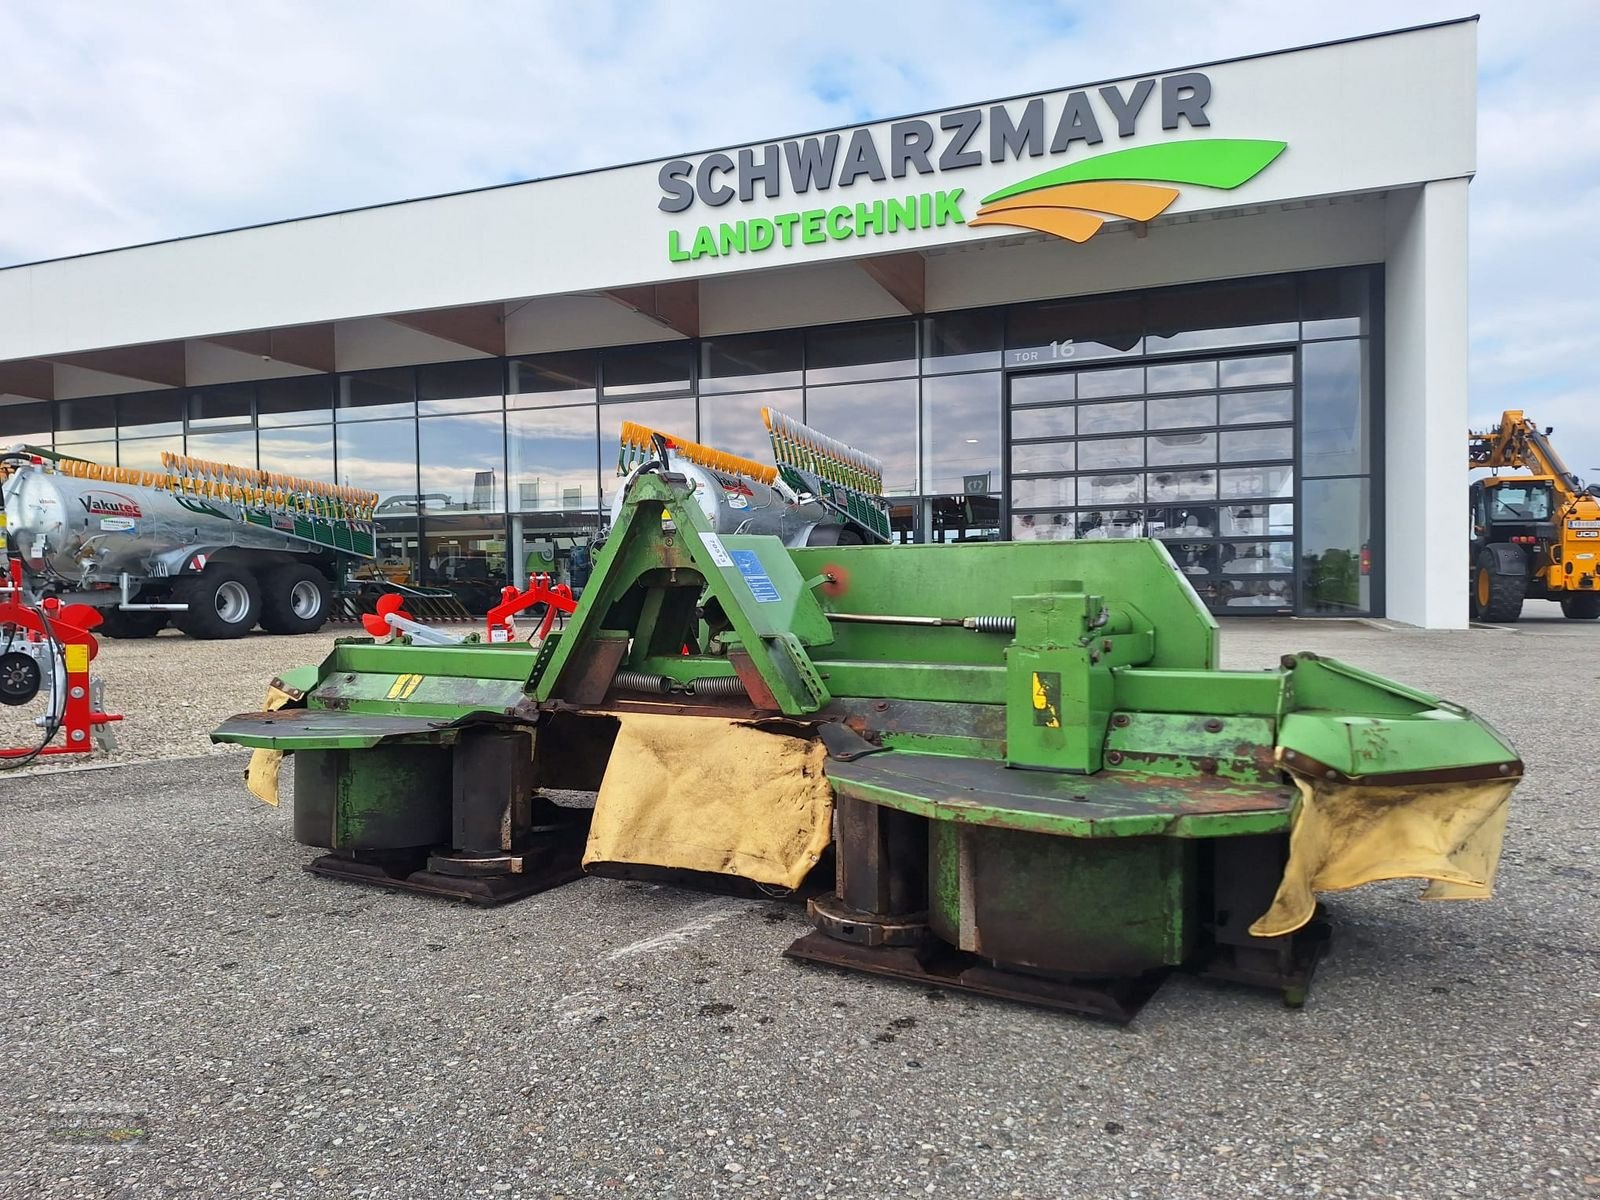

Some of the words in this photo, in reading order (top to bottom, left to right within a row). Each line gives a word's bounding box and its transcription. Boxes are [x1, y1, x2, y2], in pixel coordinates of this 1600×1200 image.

[657, 71, 1213, 213] SCHWARZMAYR
[668, 187, 967, 263] LANDTECHNIK
[1014, 351, 1039, 362] TOR
[1050, 338, 1075, 358] 16
[78, 495, 142, 514] Vakutec
